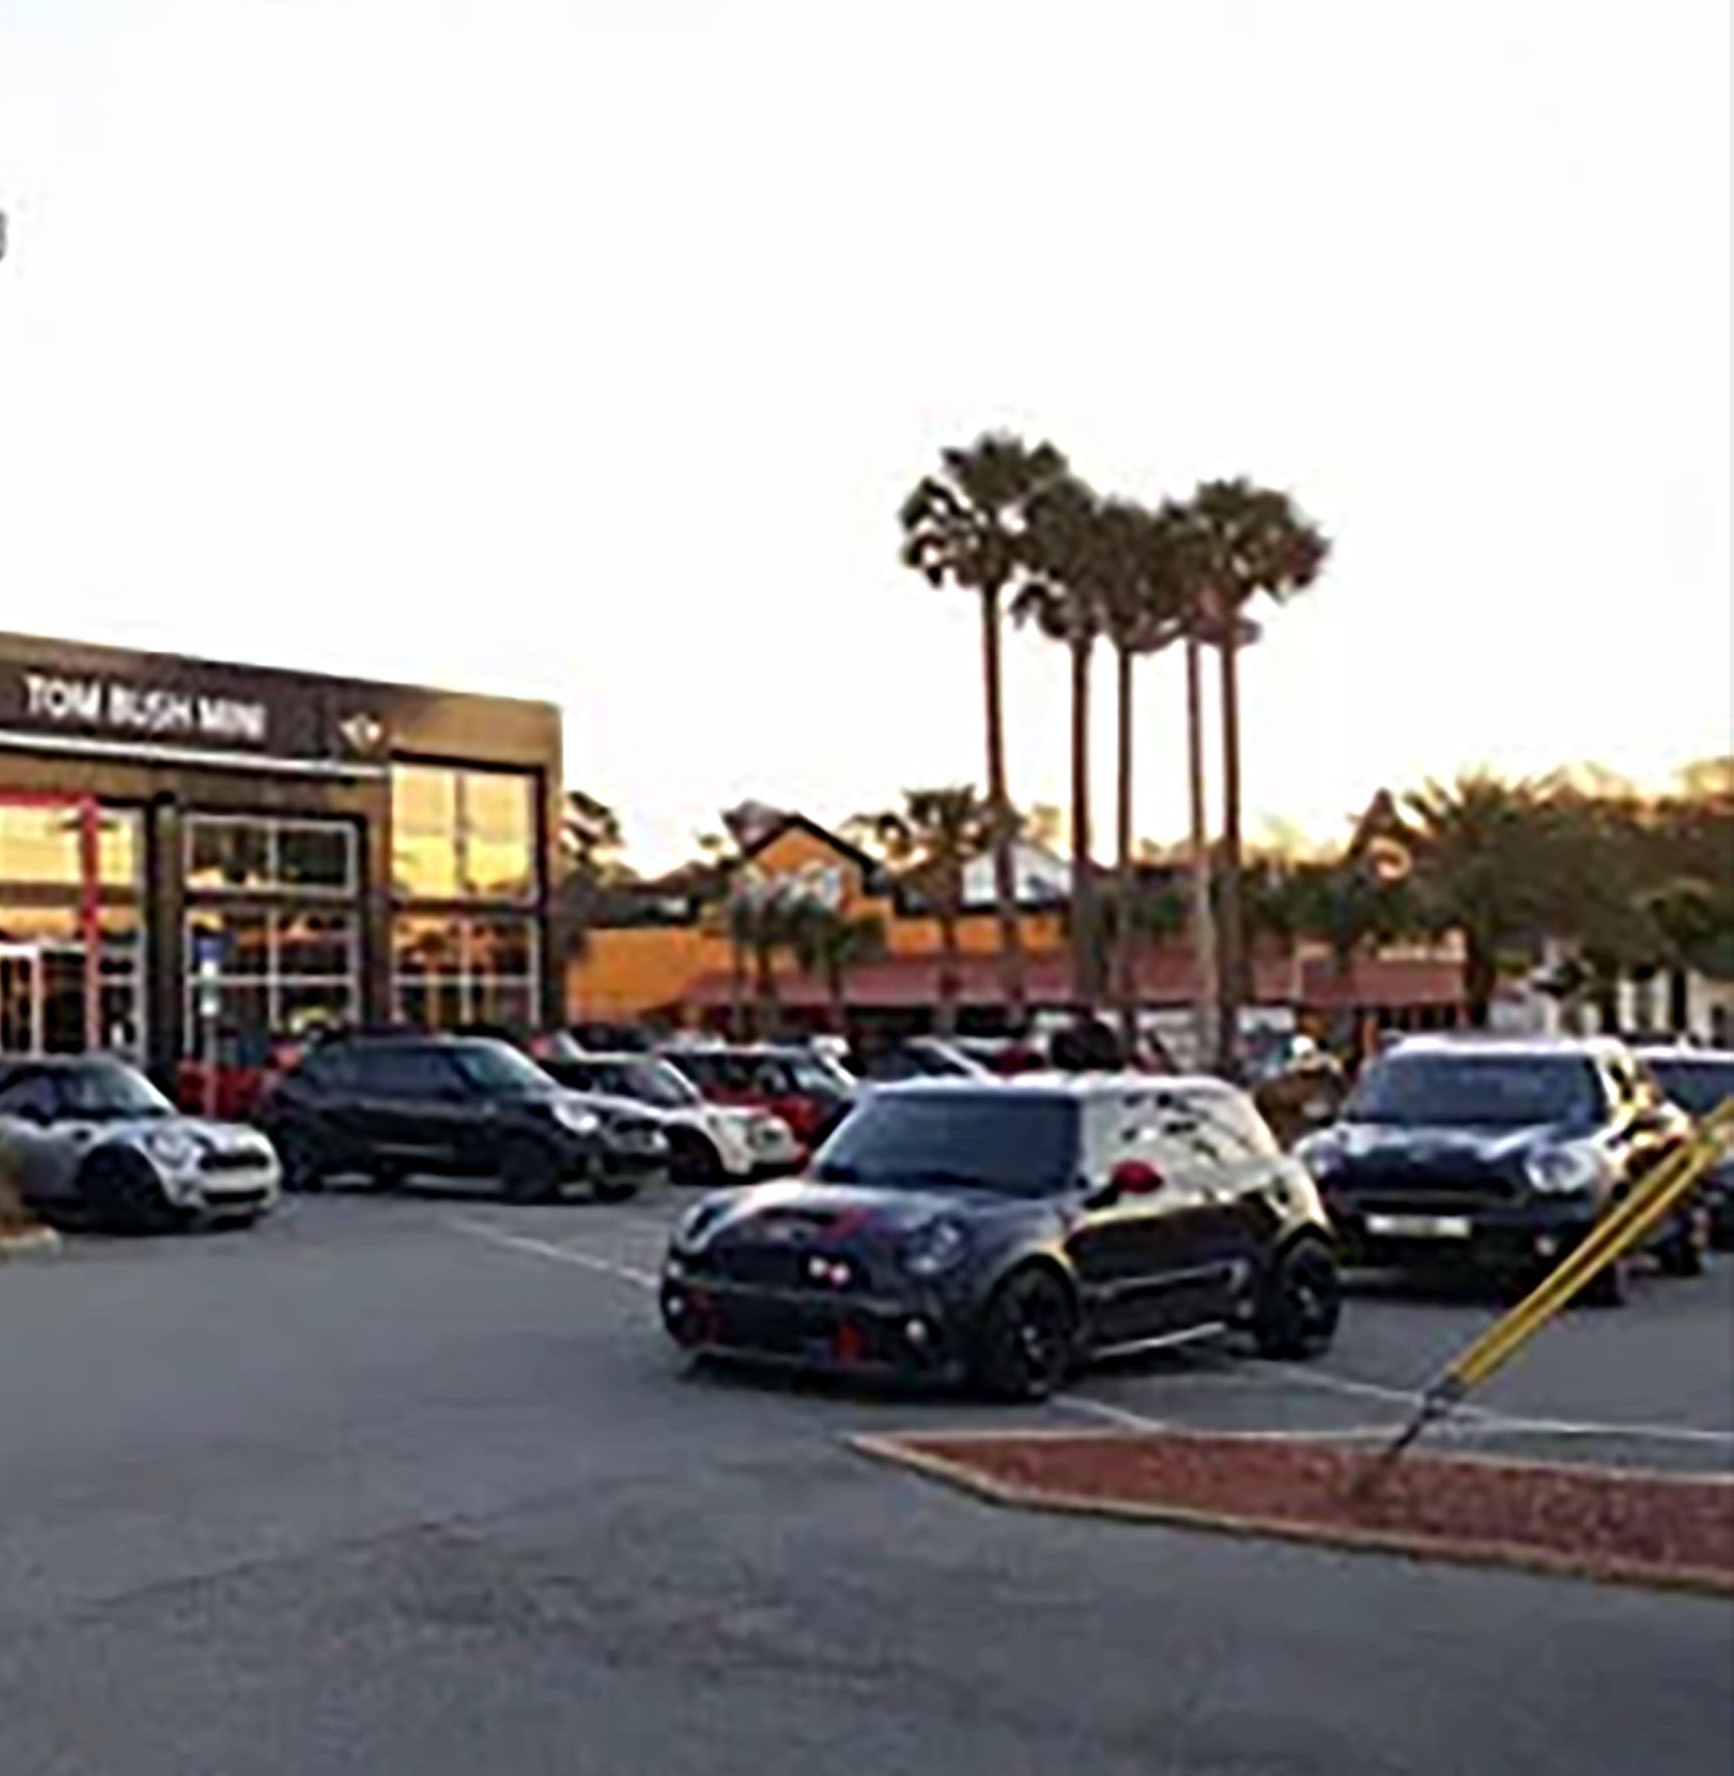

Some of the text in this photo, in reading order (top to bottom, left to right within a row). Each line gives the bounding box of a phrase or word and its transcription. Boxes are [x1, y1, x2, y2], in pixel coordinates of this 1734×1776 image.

[23, 674, 266, 740] TOM BUSH MINI
